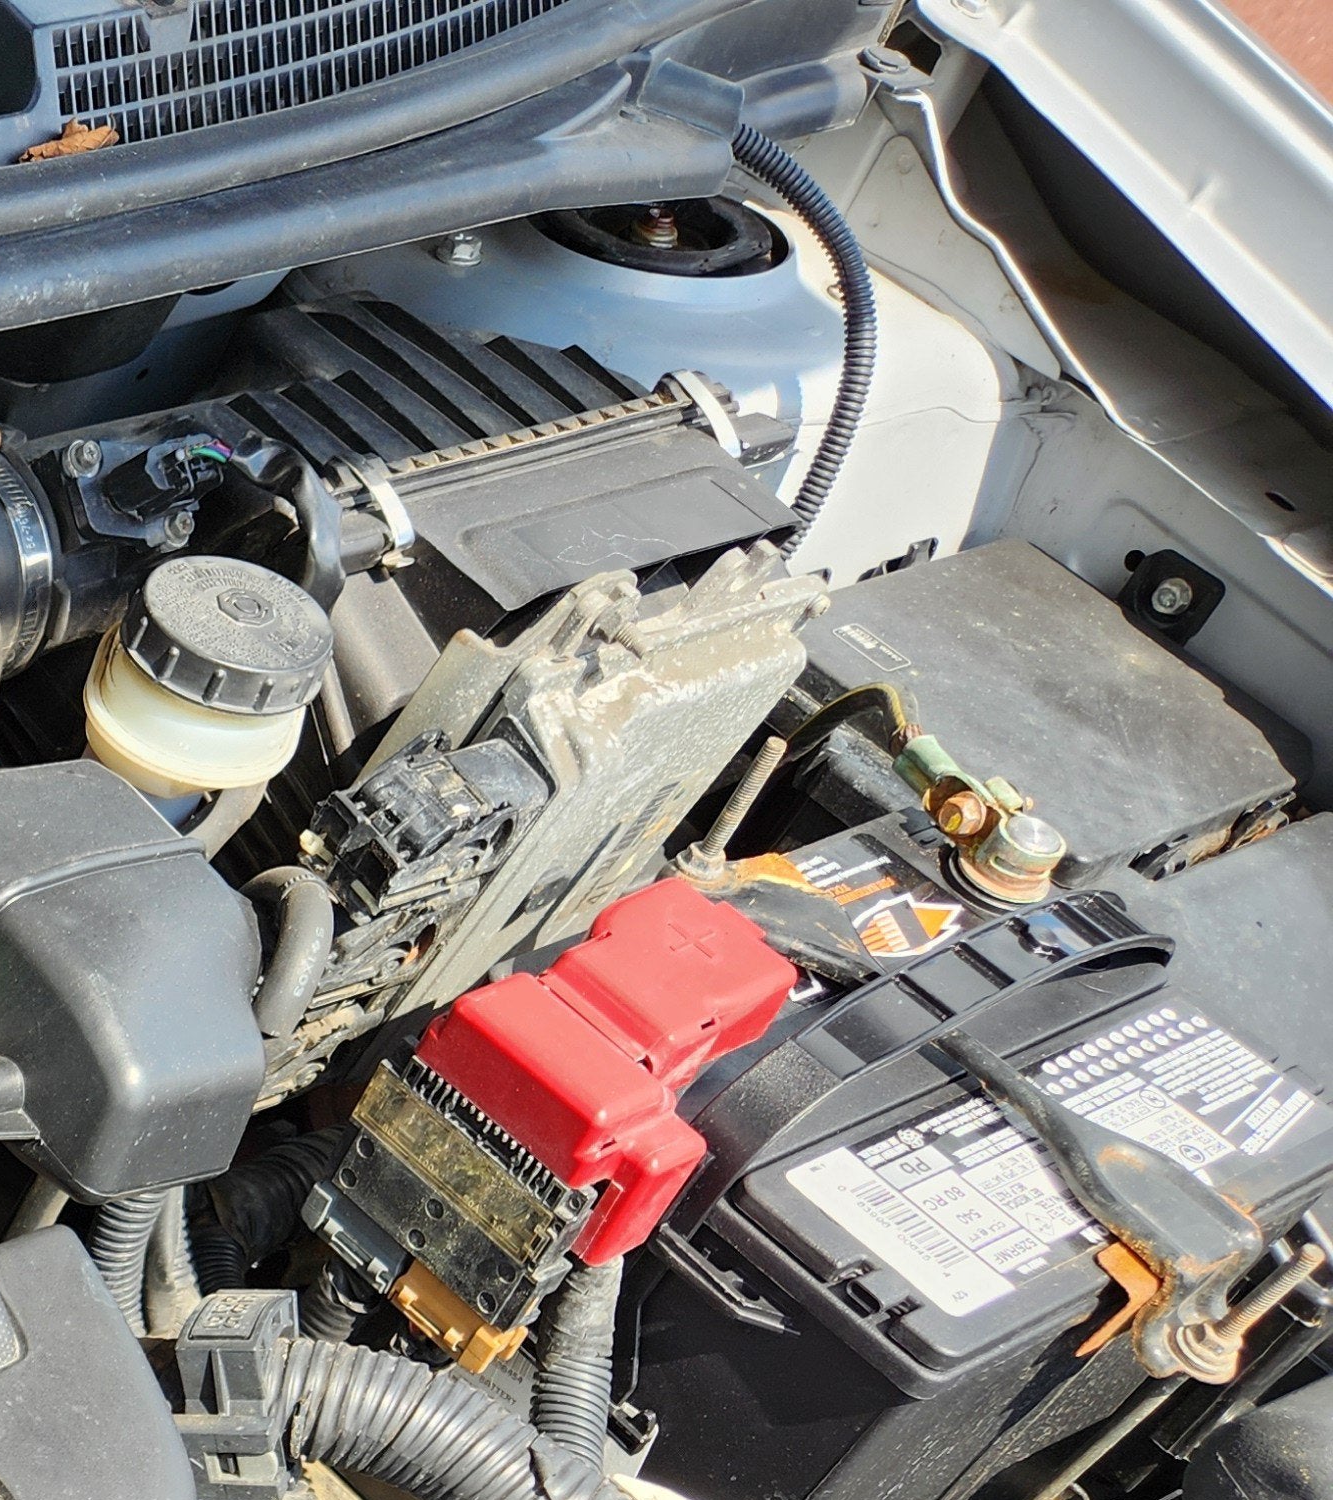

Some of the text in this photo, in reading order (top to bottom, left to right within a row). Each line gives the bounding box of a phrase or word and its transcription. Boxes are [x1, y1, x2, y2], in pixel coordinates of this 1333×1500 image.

[900, 1156, 931, 1178] Pb
[920, 1184, 966, 1213] 80 RC
[953, 1205, 982, 1226] 540
[479, 1376, 516, 1406] BATTERY
